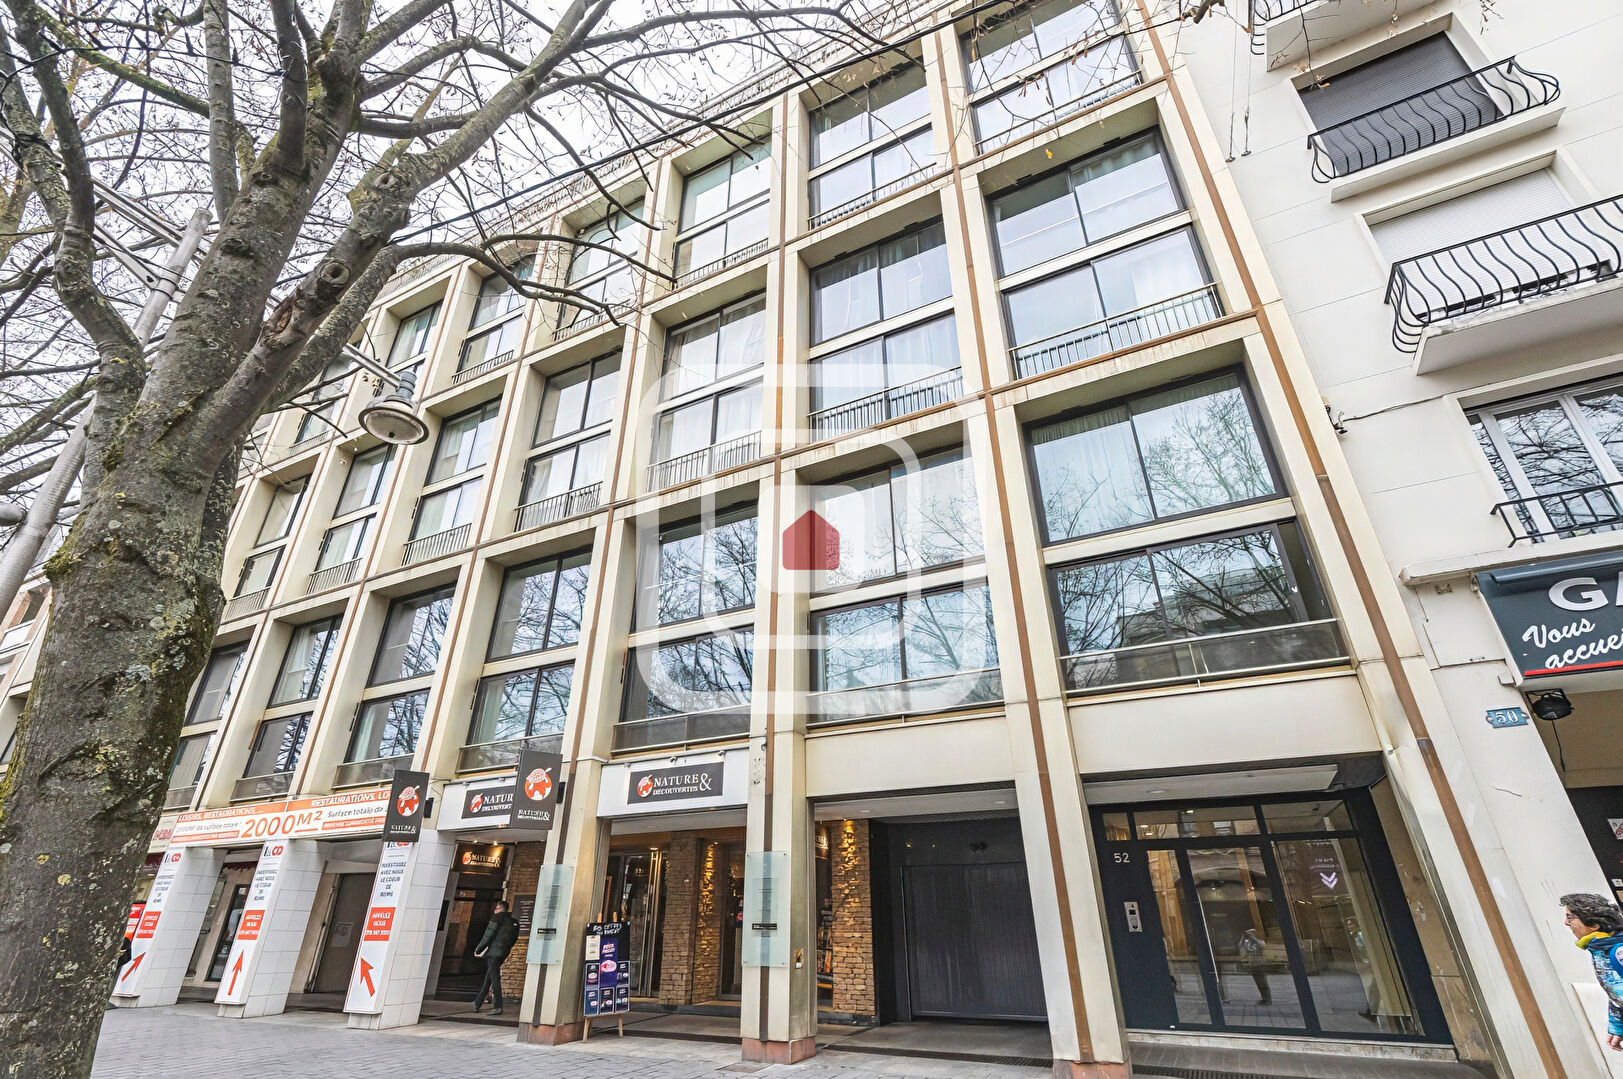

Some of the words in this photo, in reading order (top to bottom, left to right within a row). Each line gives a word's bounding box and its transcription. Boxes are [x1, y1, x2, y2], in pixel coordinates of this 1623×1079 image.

[1521, 618, 1596, 649] Vous
[1495, 709, 1519, 724] 50
[653, 773, 699, 788] NATURE
[699, 772, 712, 791] &
[1113, 852, 1131, 863] 52
